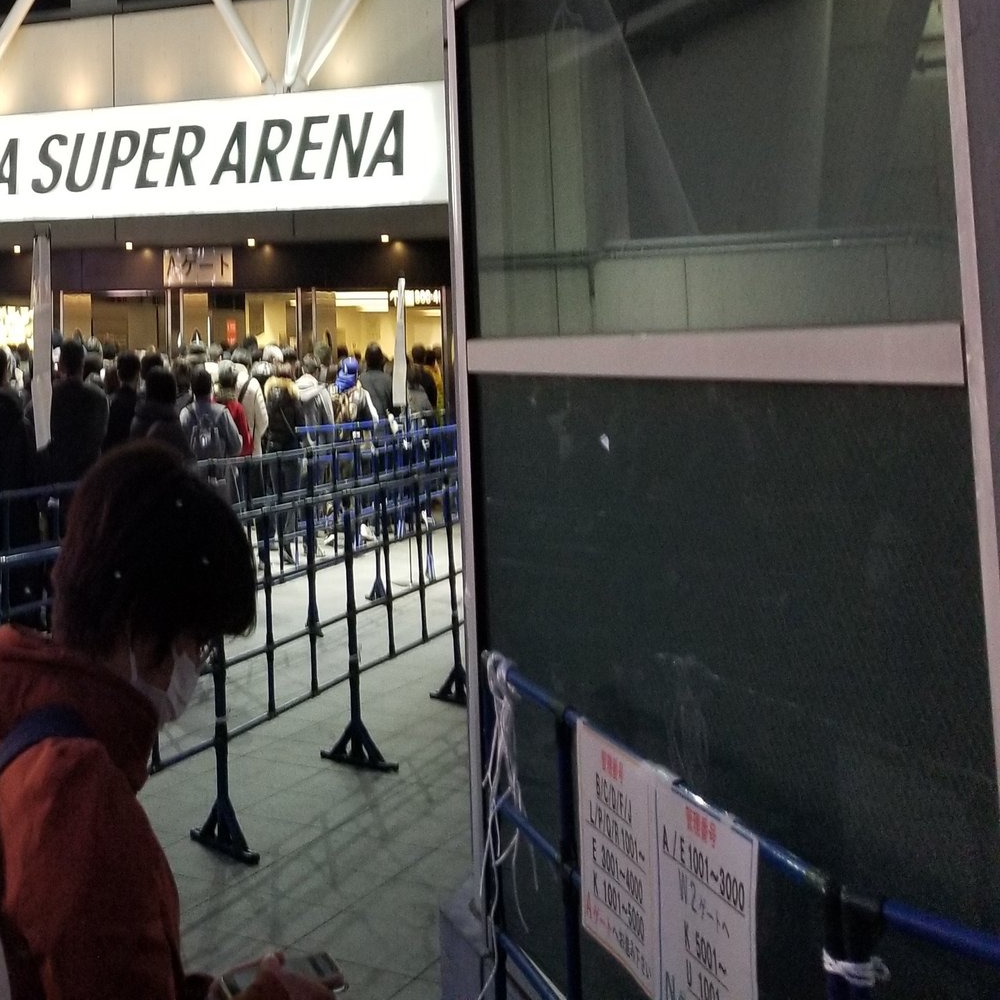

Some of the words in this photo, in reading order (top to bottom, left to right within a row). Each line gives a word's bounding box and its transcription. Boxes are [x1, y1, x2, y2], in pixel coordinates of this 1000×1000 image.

[31, 125, 205, 194] SUPER
[210, 110, 405, 187] ARENA
[684, 921, 690, 951] K
[685, 959, 692, 988] U
